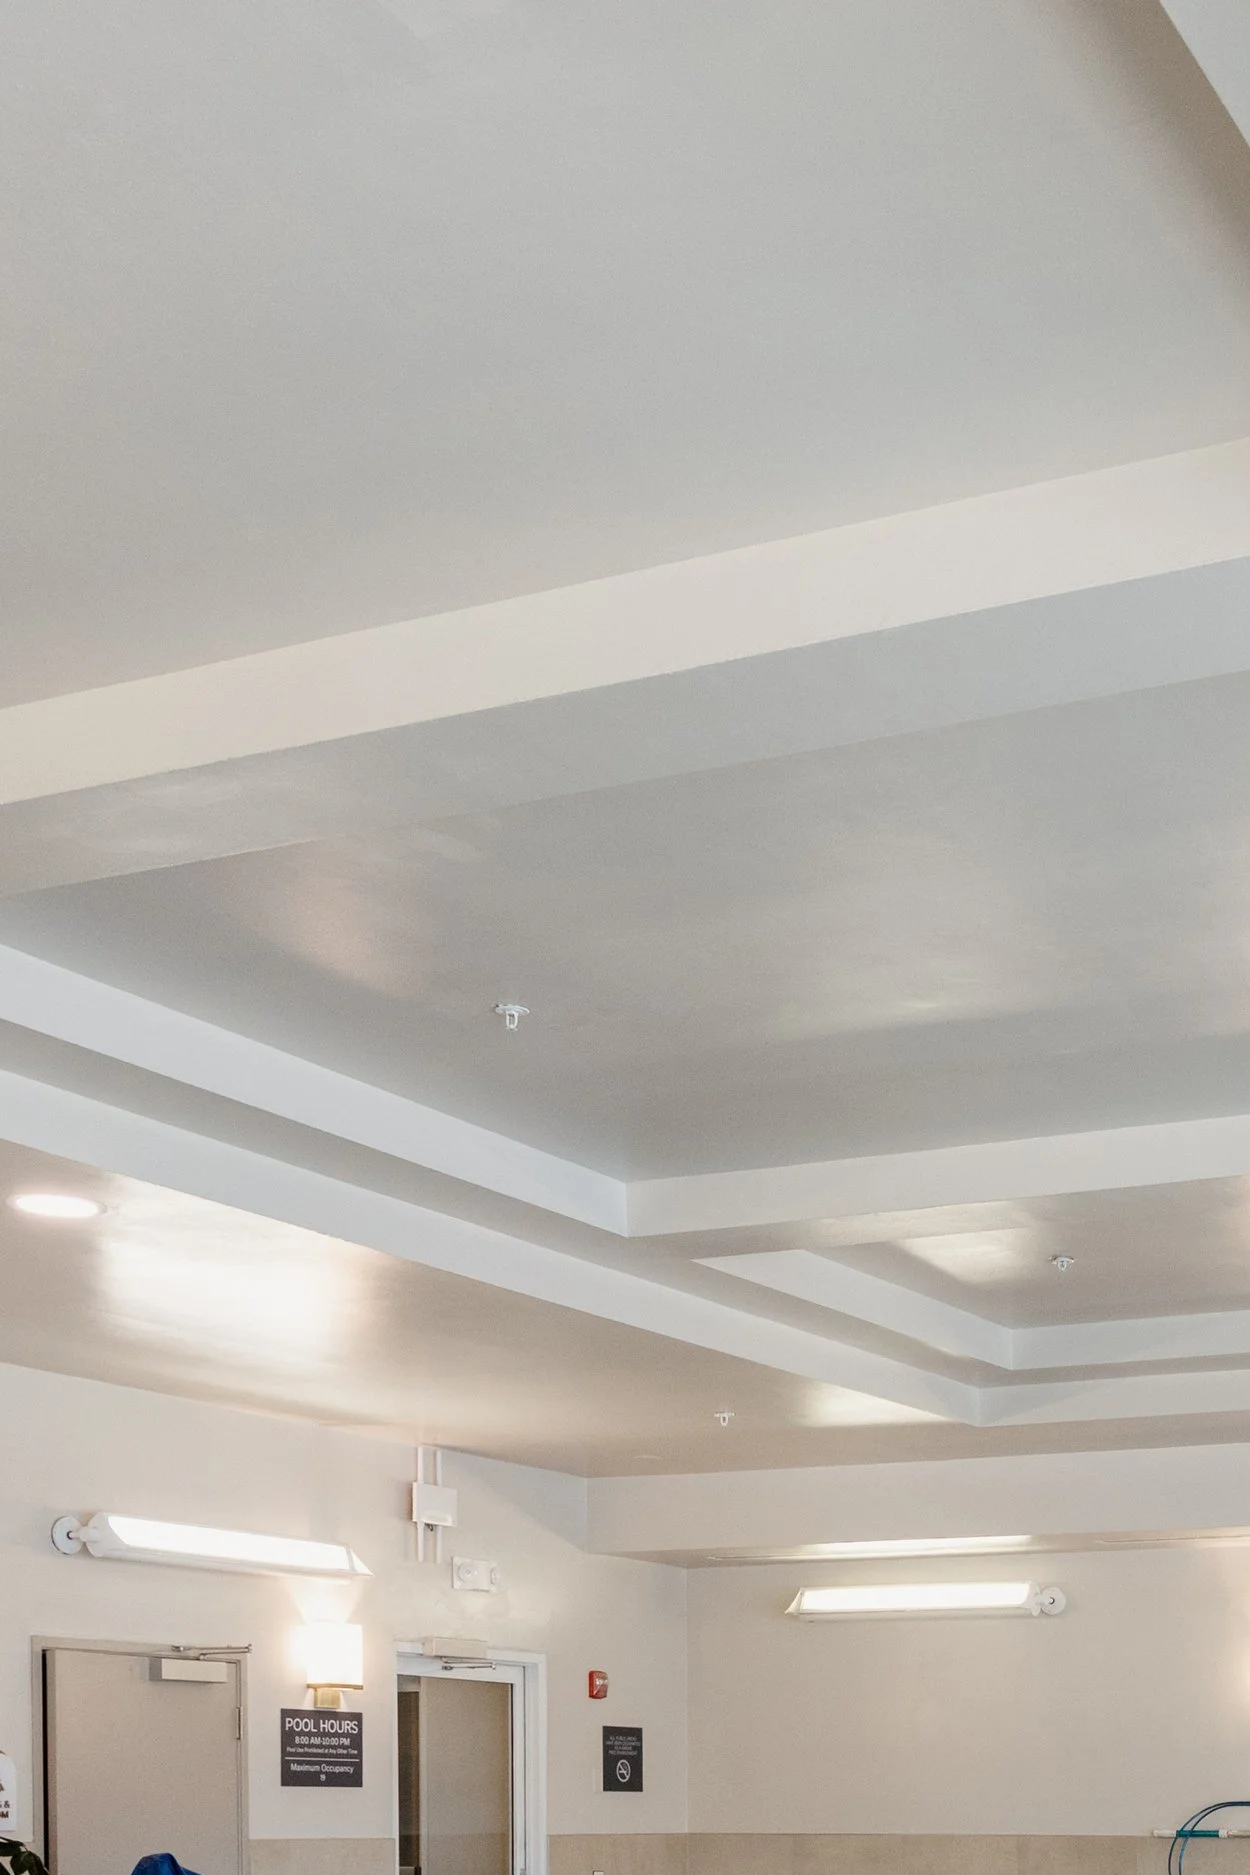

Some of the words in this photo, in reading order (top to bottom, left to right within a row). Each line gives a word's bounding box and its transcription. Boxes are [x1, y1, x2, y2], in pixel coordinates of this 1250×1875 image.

[285, 1718, 317, 1732] POOL
[320, 1720, 358, 1734] HOURS
[295, 1736, 309, 1744] 8:00
[290, 1763, 320, 1771] Maximum
[321, 1764, 353, 1773] Occupancy
